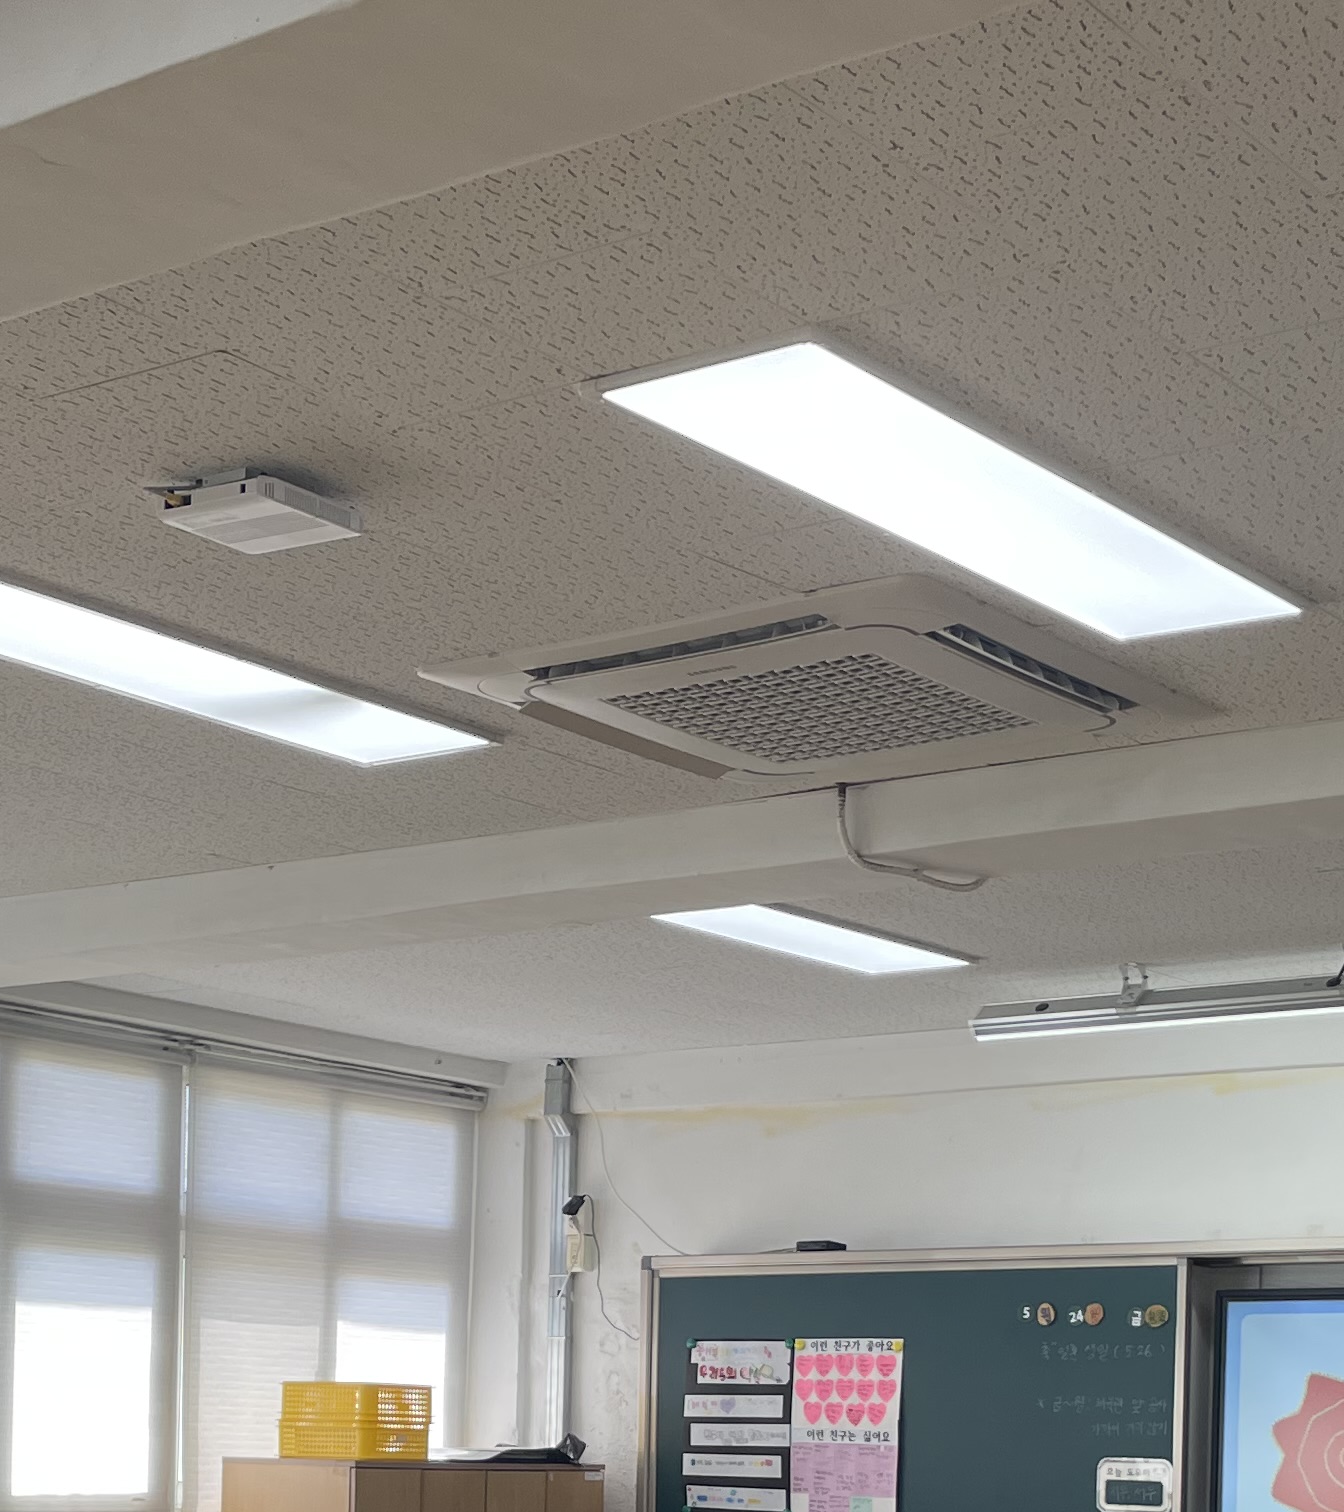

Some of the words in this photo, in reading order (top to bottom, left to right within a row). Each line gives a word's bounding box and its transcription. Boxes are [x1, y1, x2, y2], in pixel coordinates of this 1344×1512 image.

[1022, 1307, 1030, 1318] 5
[1069, 1309, 1083, 1323] 24
[810, 1340, 828, 1351] 이런
[833, 1340, 861, 1351] 친구가
[866, 1341, 894, 1351] 좋아요
[806, 1430, 824, 1440] 이런
[830, 1429, 856, 1442] 친구는
[863, 1431, 890, 1442] 싫어요
